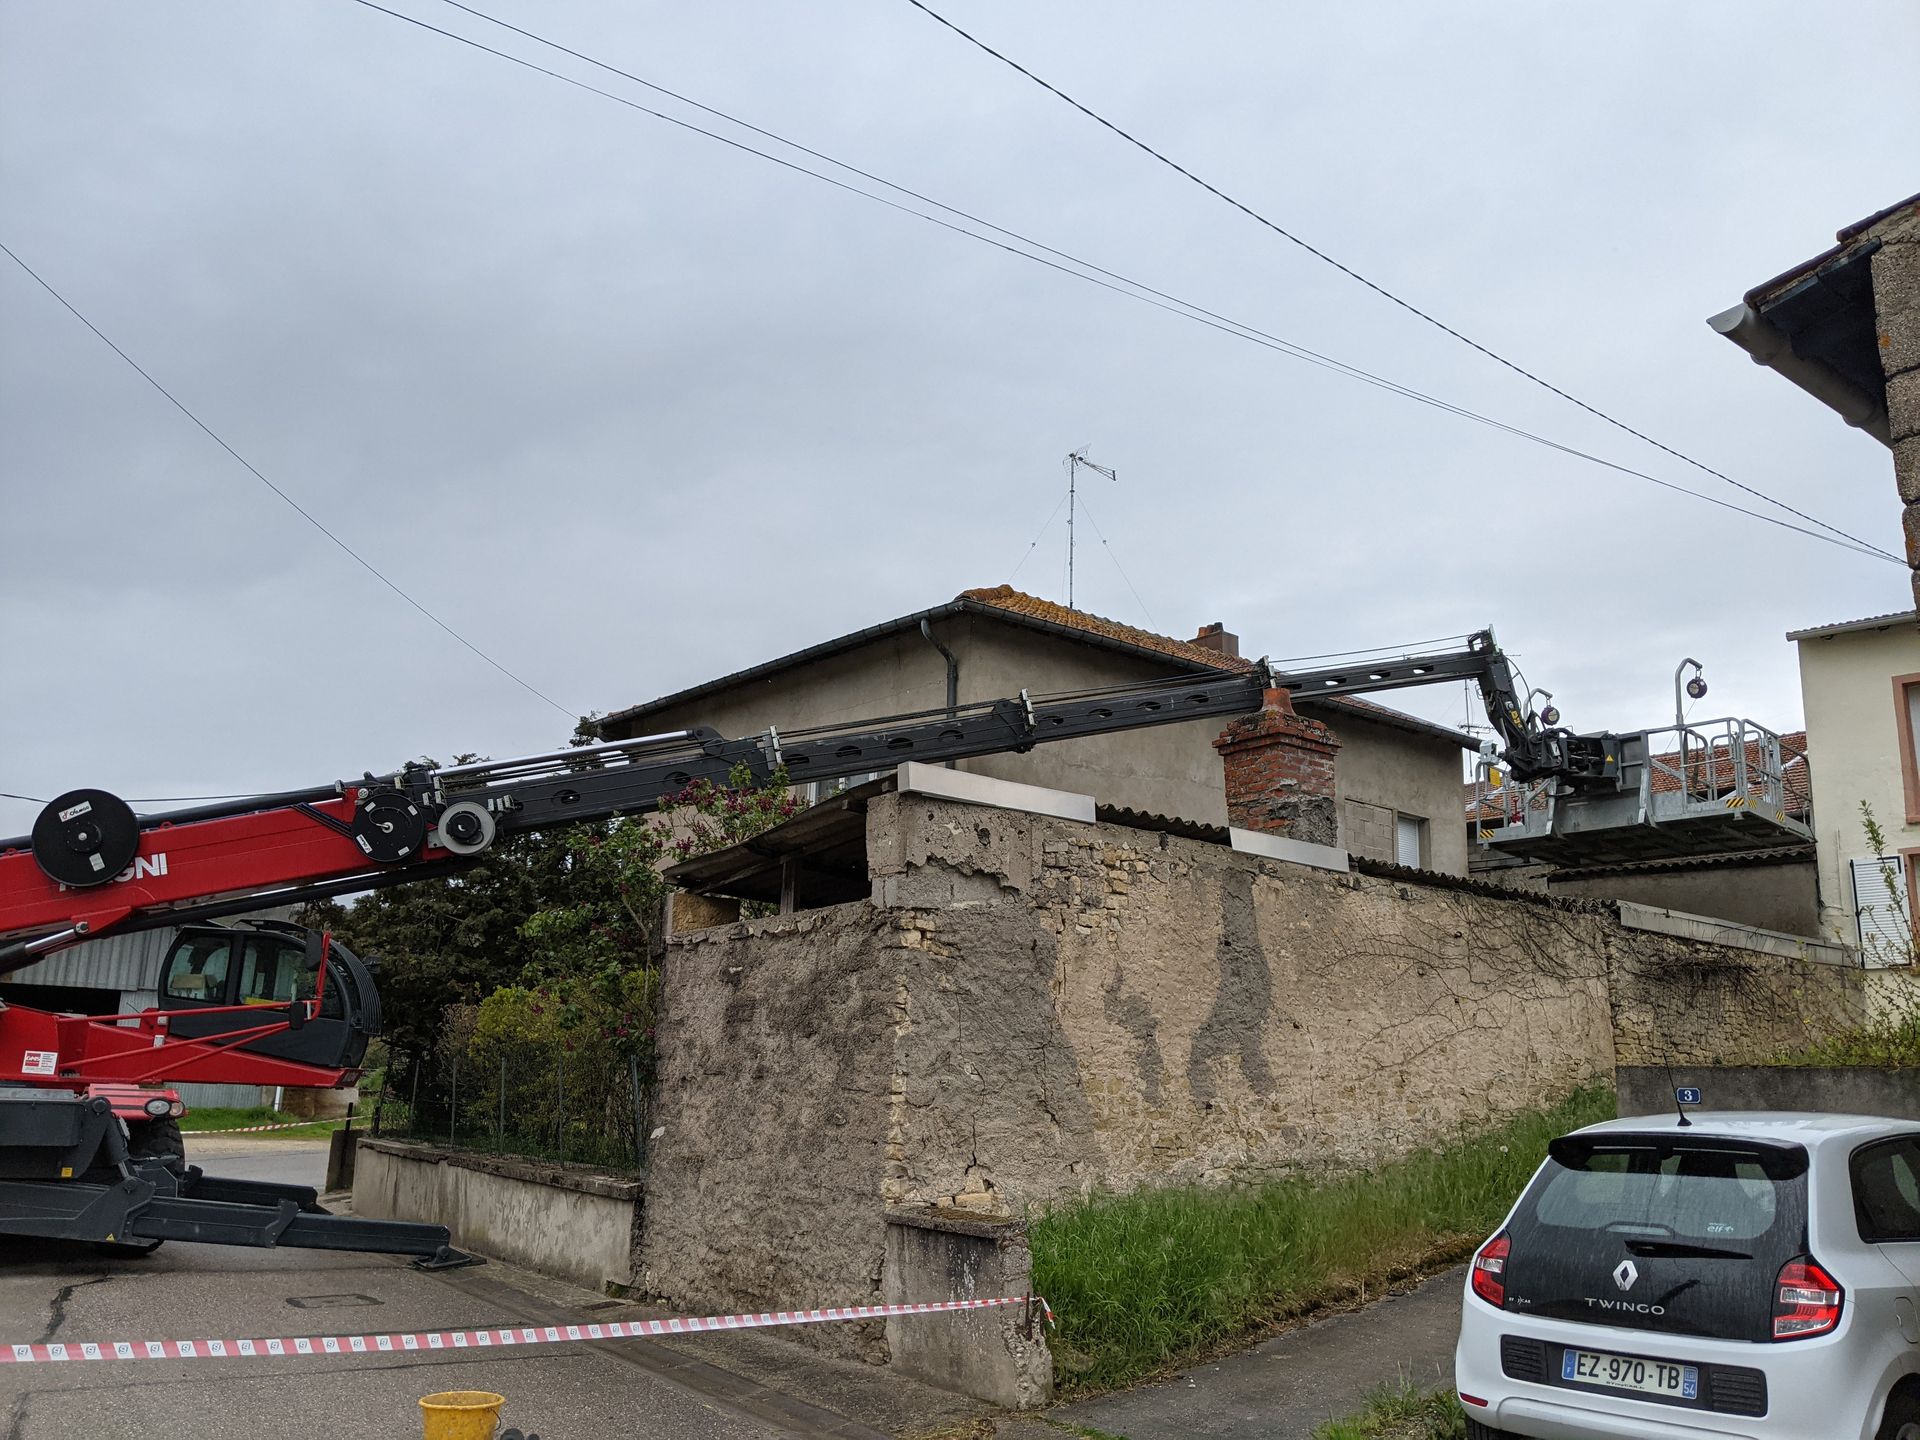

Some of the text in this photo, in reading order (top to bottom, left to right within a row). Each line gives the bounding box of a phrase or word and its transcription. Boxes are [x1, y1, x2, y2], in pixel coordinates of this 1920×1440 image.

[1684, 1090, 1693, 1101] 3
[1584, 1297, 1665, 1316] TWINGO
[1576, 1353, 1680, 1390] EZ-970-TB
[1683, 1384, 1695, 1396] 54
